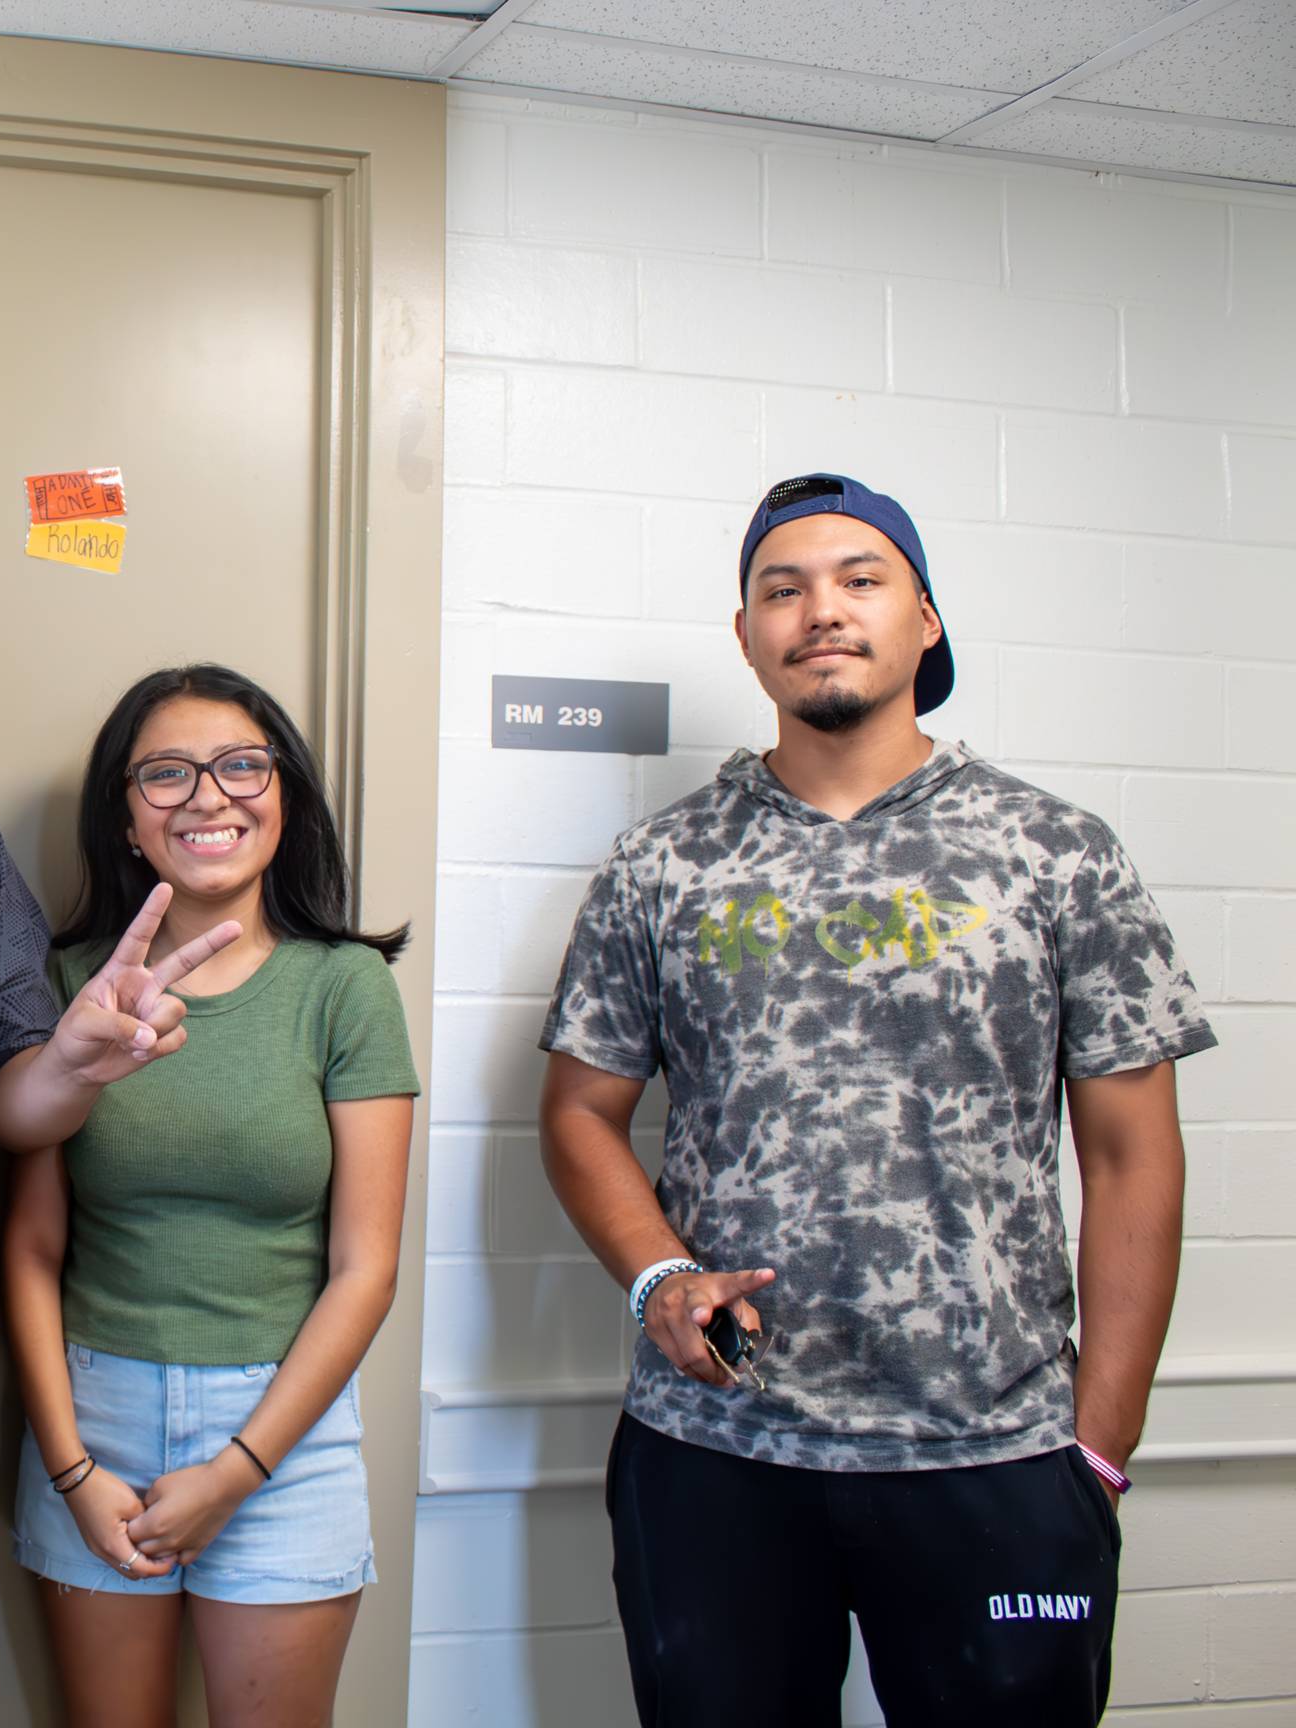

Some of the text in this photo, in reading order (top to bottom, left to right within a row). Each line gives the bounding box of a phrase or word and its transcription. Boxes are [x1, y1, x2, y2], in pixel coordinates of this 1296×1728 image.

[56, 488, 97, 515] ONE
[47, 523, 119, 559] Rolando
[505, 703, 603, 728] RM 239
[698, 892, 792, 976] NO
[988, 1593, 1091, 1620] OLD NAVY
